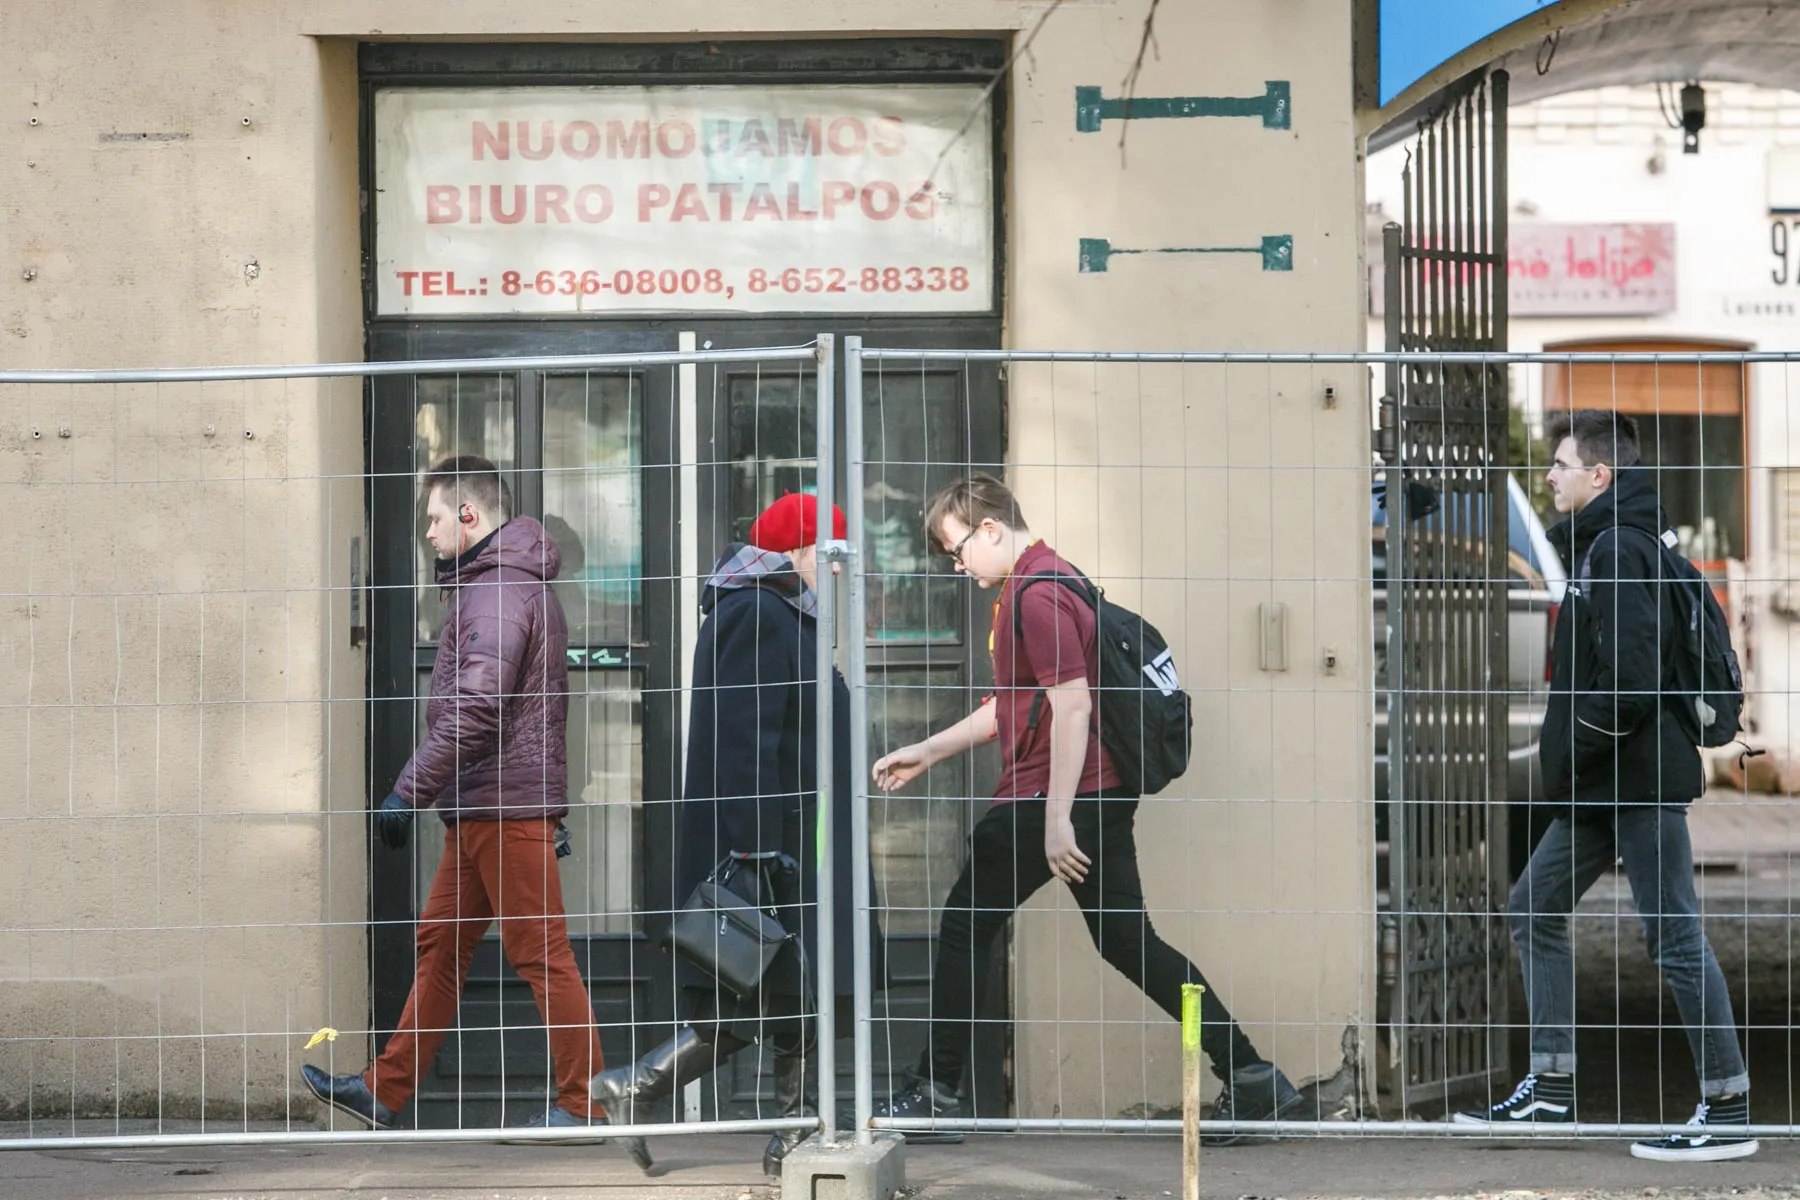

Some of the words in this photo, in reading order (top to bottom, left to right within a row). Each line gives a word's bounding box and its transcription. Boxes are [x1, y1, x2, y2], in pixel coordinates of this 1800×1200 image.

[472, 116, 907, 161] NUOMOJAMOS
[425, 183, 615, 226] BIURO
[637, 181, 940, 223] PATALPOS
[395, 270, 488, 297] TEL.:
[501, 268, 735, 300] 8-636-08008,
[748, 265, 971, 294] 8-652-88338
